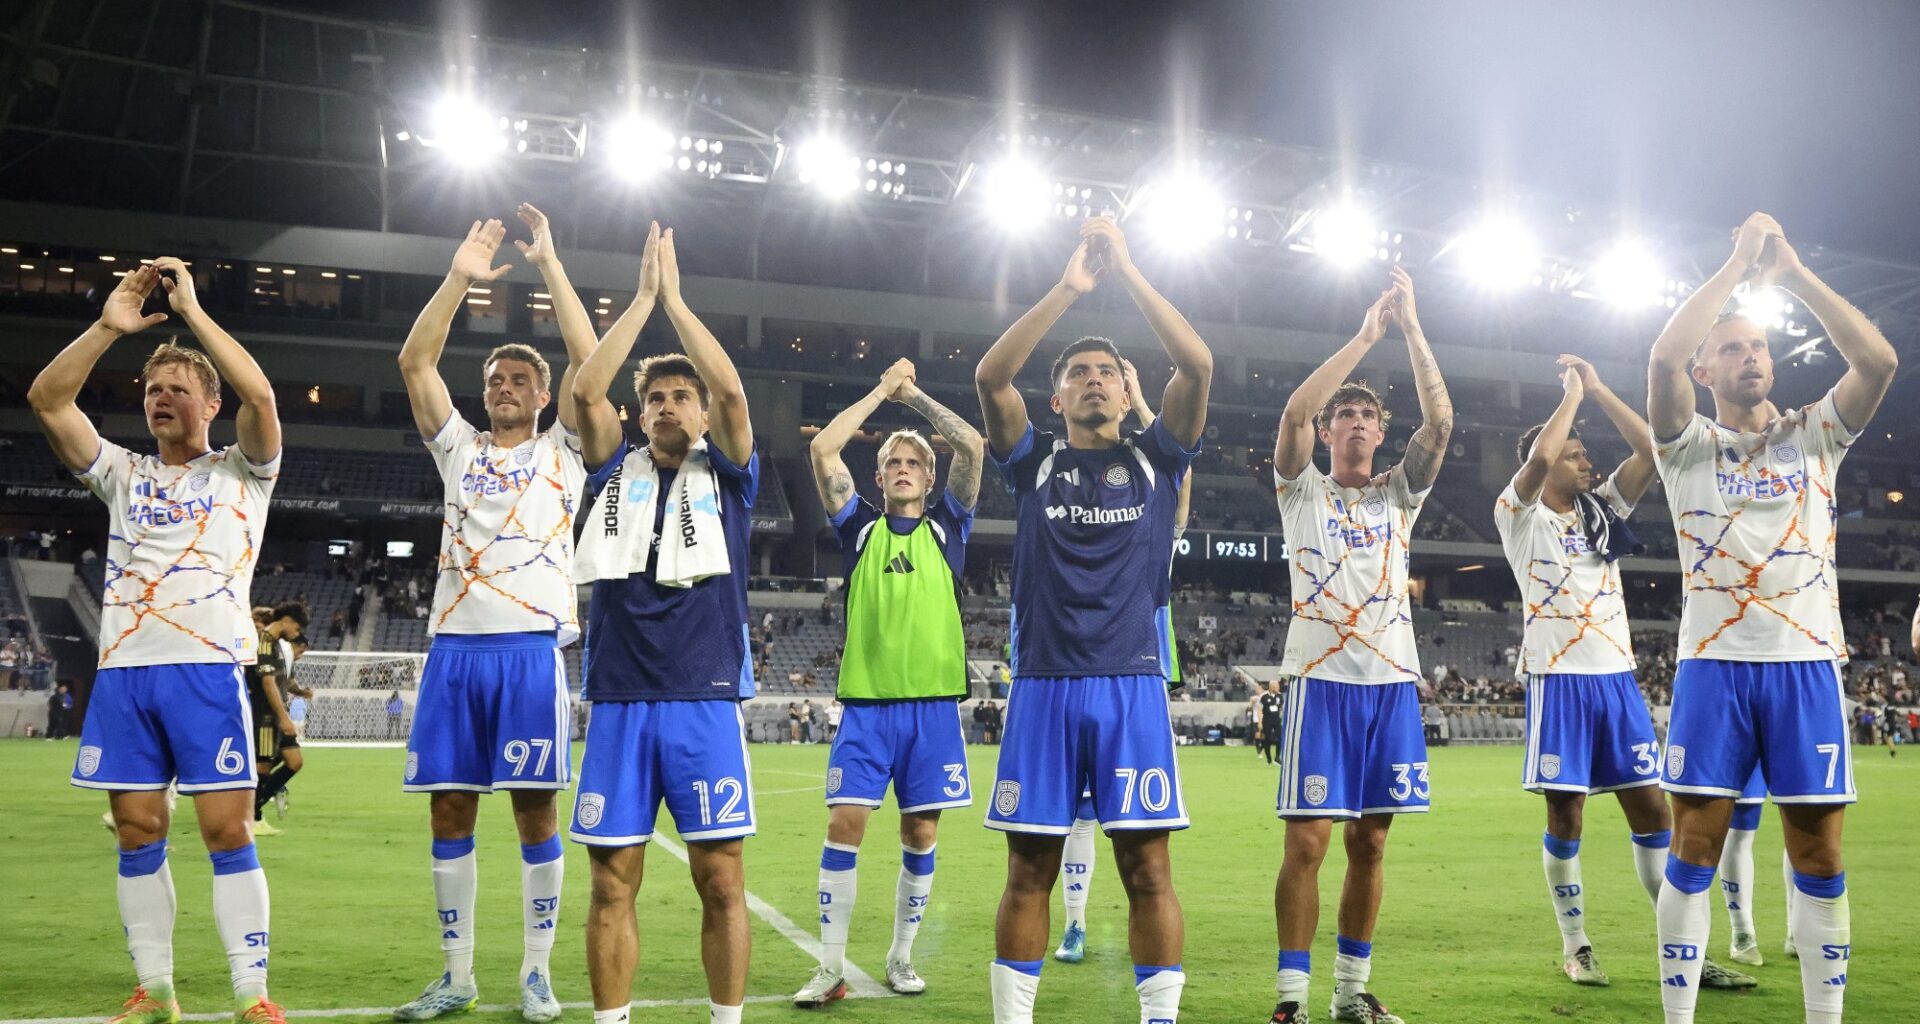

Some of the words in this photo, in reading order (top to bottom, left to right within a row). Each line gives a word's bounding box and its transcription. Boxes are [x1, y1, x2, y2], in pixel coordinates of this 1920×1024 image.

[1069, 503, 1145, 524] Palomar
[1215, 541, 1257, 558] 97:53
[215, 737, 245, 776] 6
[503, 738, 553, 777] 97
[1815, 743, 1840, 789] 7
[942, 763, 967, 798] 3
[1114, 767, 1171, 814] 70
[1388, 761, 1431, 801] 33
[692, 776, 746, 826] 12
[1064, 863, 1086, 874] SD
[1554, 884, 1581, 898] SD
[1663, 943, 1699, 961] SD
